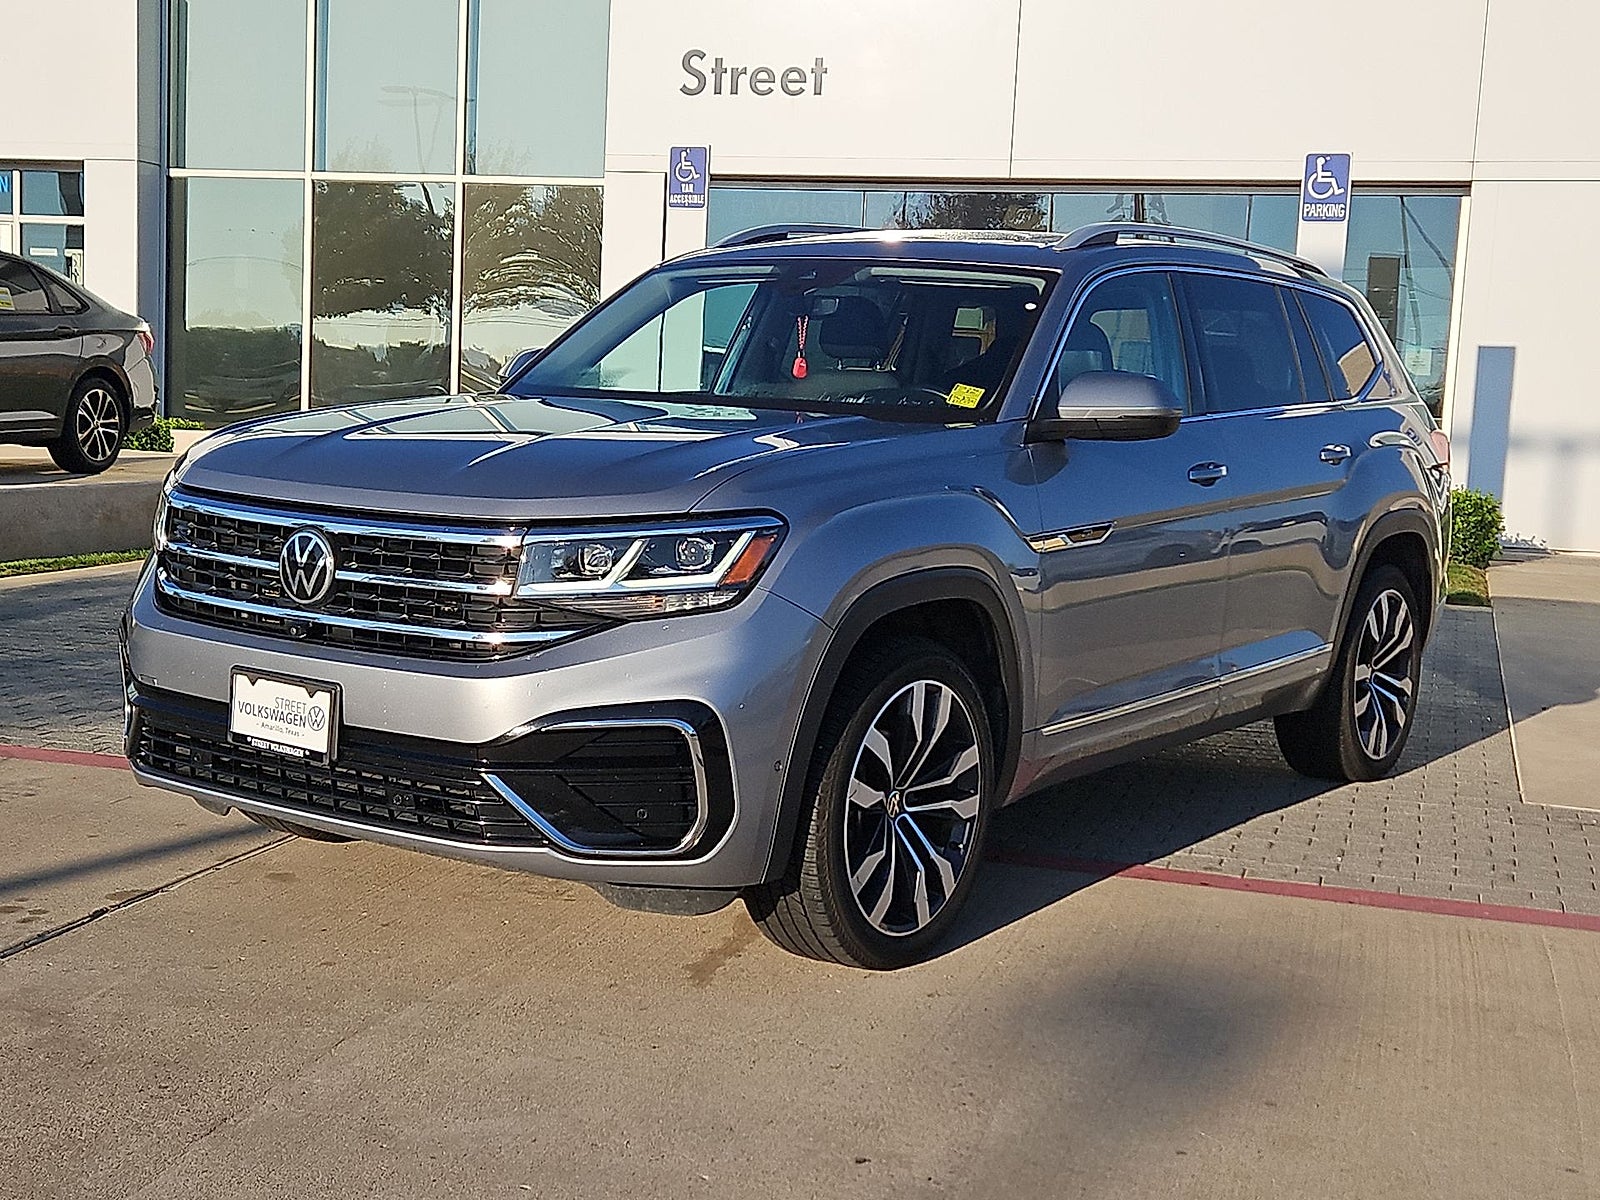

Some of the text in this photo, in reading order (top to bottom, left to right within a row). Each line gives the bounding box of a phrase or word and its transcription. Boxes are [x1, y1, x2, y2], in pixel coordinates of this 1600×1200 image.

[680, 49, 828, 96] Street
[1303, 203, 1346, 217] PARKING
[238, 700, 307, 729] VOLKSWAGEN
[274, 696, 307, 715] STREET
